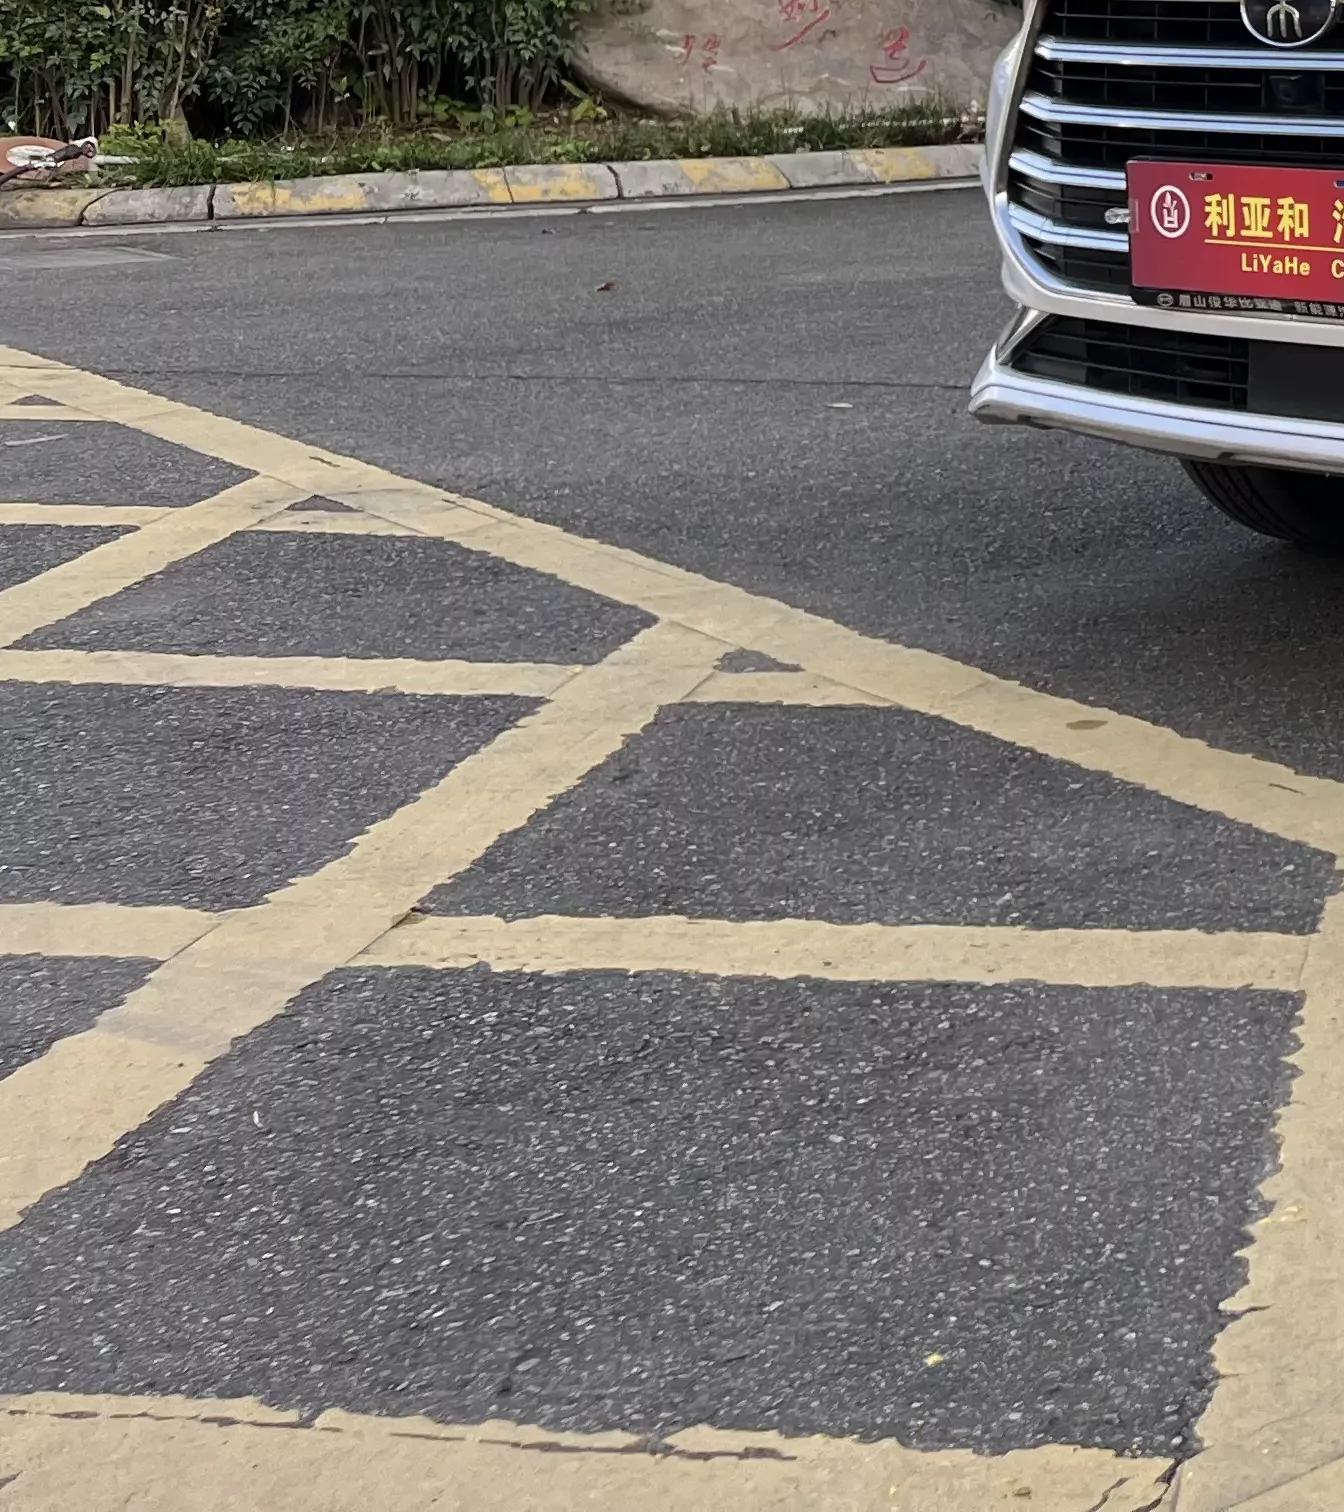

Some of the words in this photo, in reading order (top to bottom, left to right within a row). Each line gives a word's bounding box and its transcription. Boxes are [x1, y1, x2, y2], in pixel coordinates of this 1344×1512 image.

[1203, 193, 1310, 241] 利亚和
[1240, 253, 1311, 276] LiYaHe
